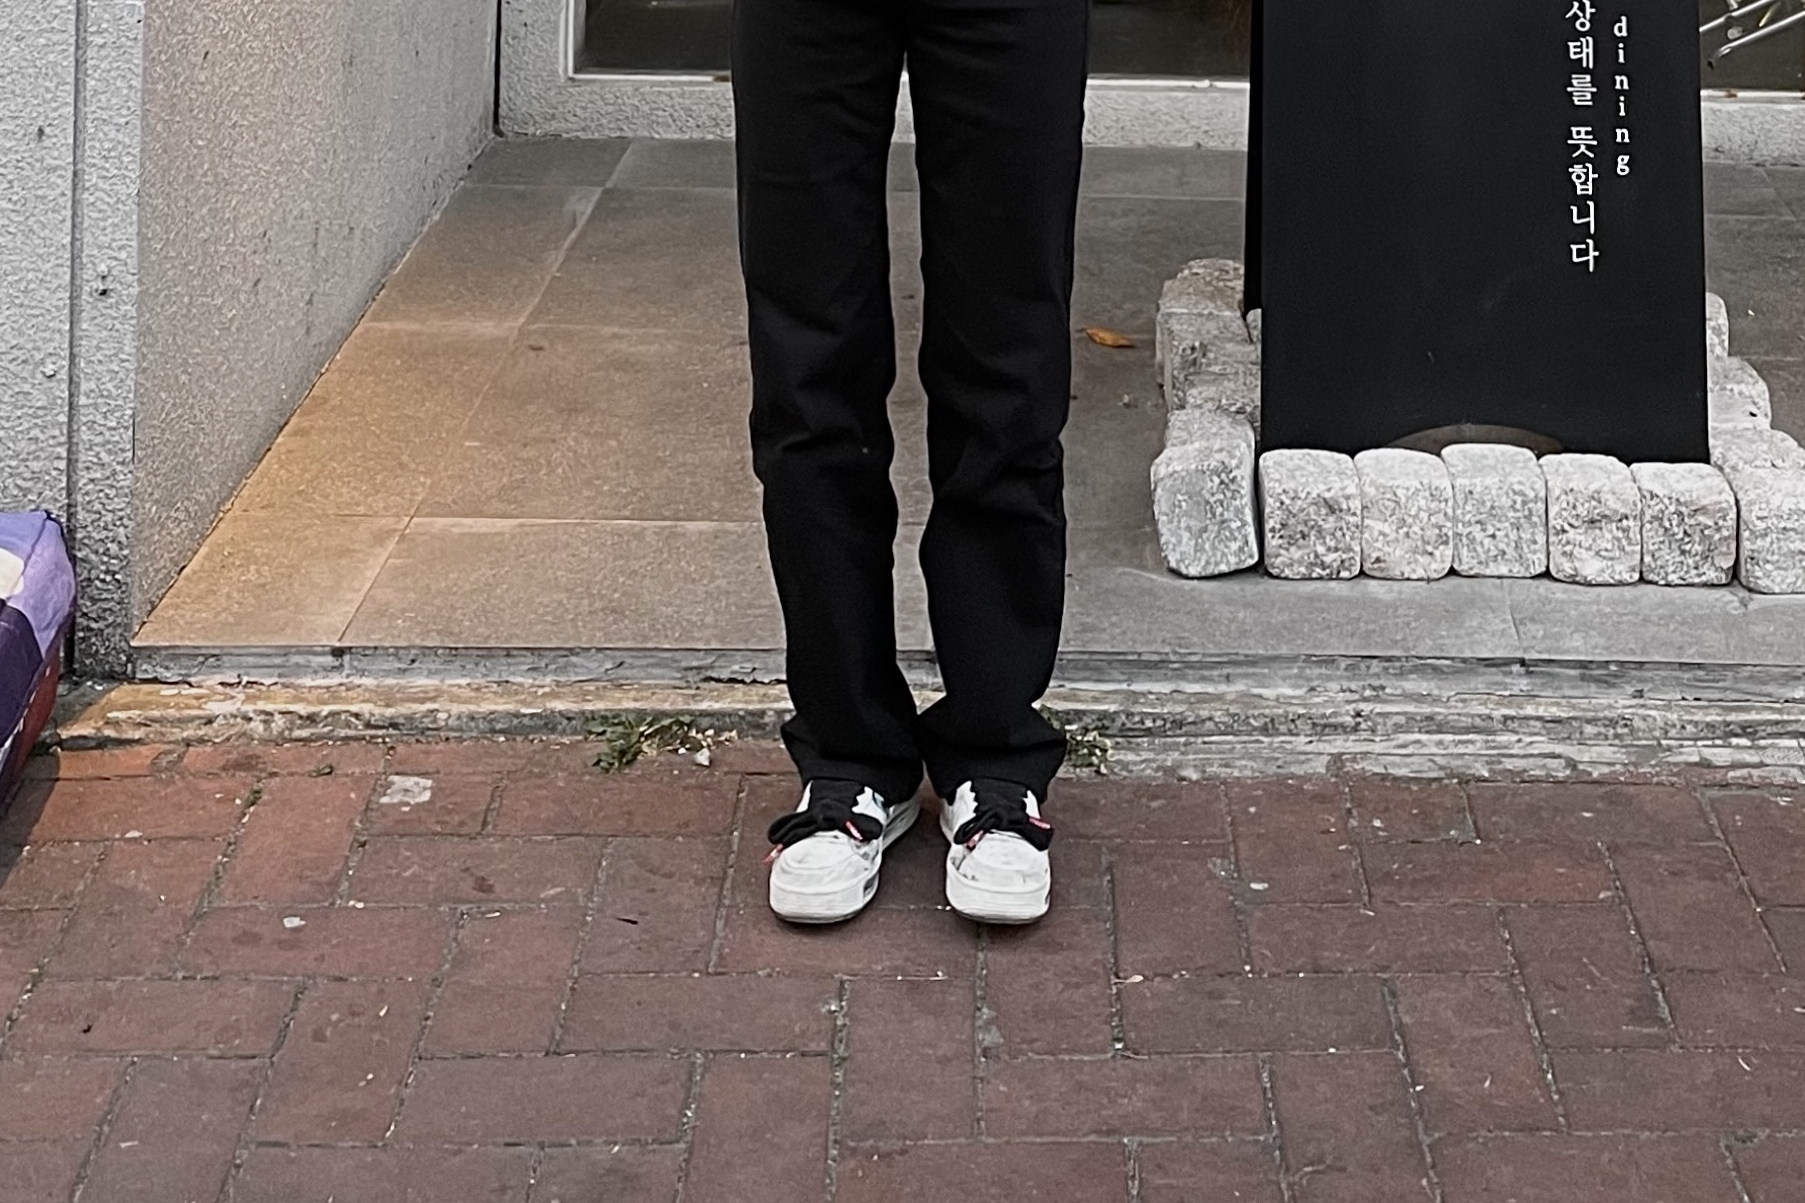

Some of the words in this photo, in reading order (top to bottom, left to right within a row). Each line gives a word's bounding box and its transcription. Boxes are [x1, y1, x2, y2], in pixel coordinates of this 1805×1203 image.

[1566, 0, 1597, 105] 상태를
[1614, 16, 1630, 175] dining
[1568, 127, 1599, 272] 뜻합니다
